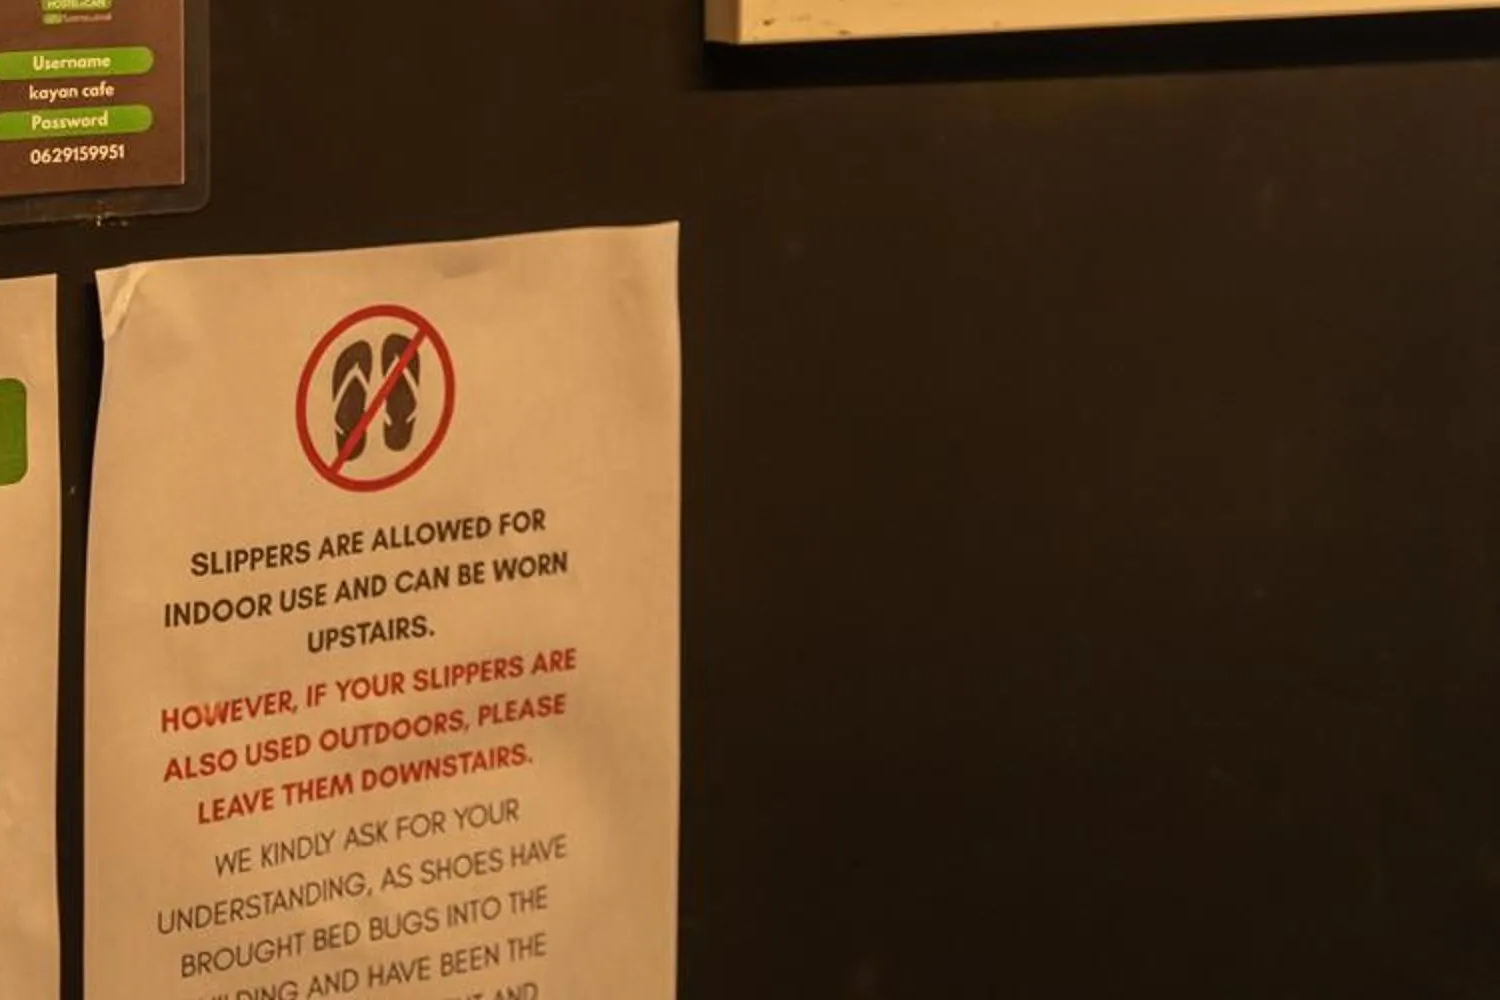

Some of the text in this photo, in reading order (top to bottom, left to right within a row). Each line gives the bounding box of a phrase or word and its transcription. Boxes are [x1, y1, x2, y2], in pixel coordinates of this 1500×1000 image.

[30, 80, 114, 102] kayan cafe
[32, 55, 111, 71] Username
[30, 144, 124, 164] 0629159951
[31, 111, 108, 131] Password
[191, 508, 545, 576] SLIPPERS ARE ALLOWED FOR
[165, 552, 567, 627] INDOOR USE AND CAN BE WORN
[308, 615, 434, 654] UPSTAIRS.
[162, 648, 576, 733] HOWEVER, IF YOUR SLIPPERS ARE
[164, 693, 566, 782] ALSO USED OUTDOORS, PLEASE
[198, 744, 532, 824] LEAVE THEM DOWNSTAIRS.
[215, 798, 519, 877] WE KINDLY ASK FOR YOUR
[158, 834, 567, 935] UNDERSTANDING, AS SHOES HAVE
[181, 885, 548, 978] BROUGHT BED BUGS INTO THE
[307, 969, 359, 1000] AND
[368, 956, 431, 989] HAVE
[440, 943, 499, 977] BEEN
[507, 932, 547, 962] THE
